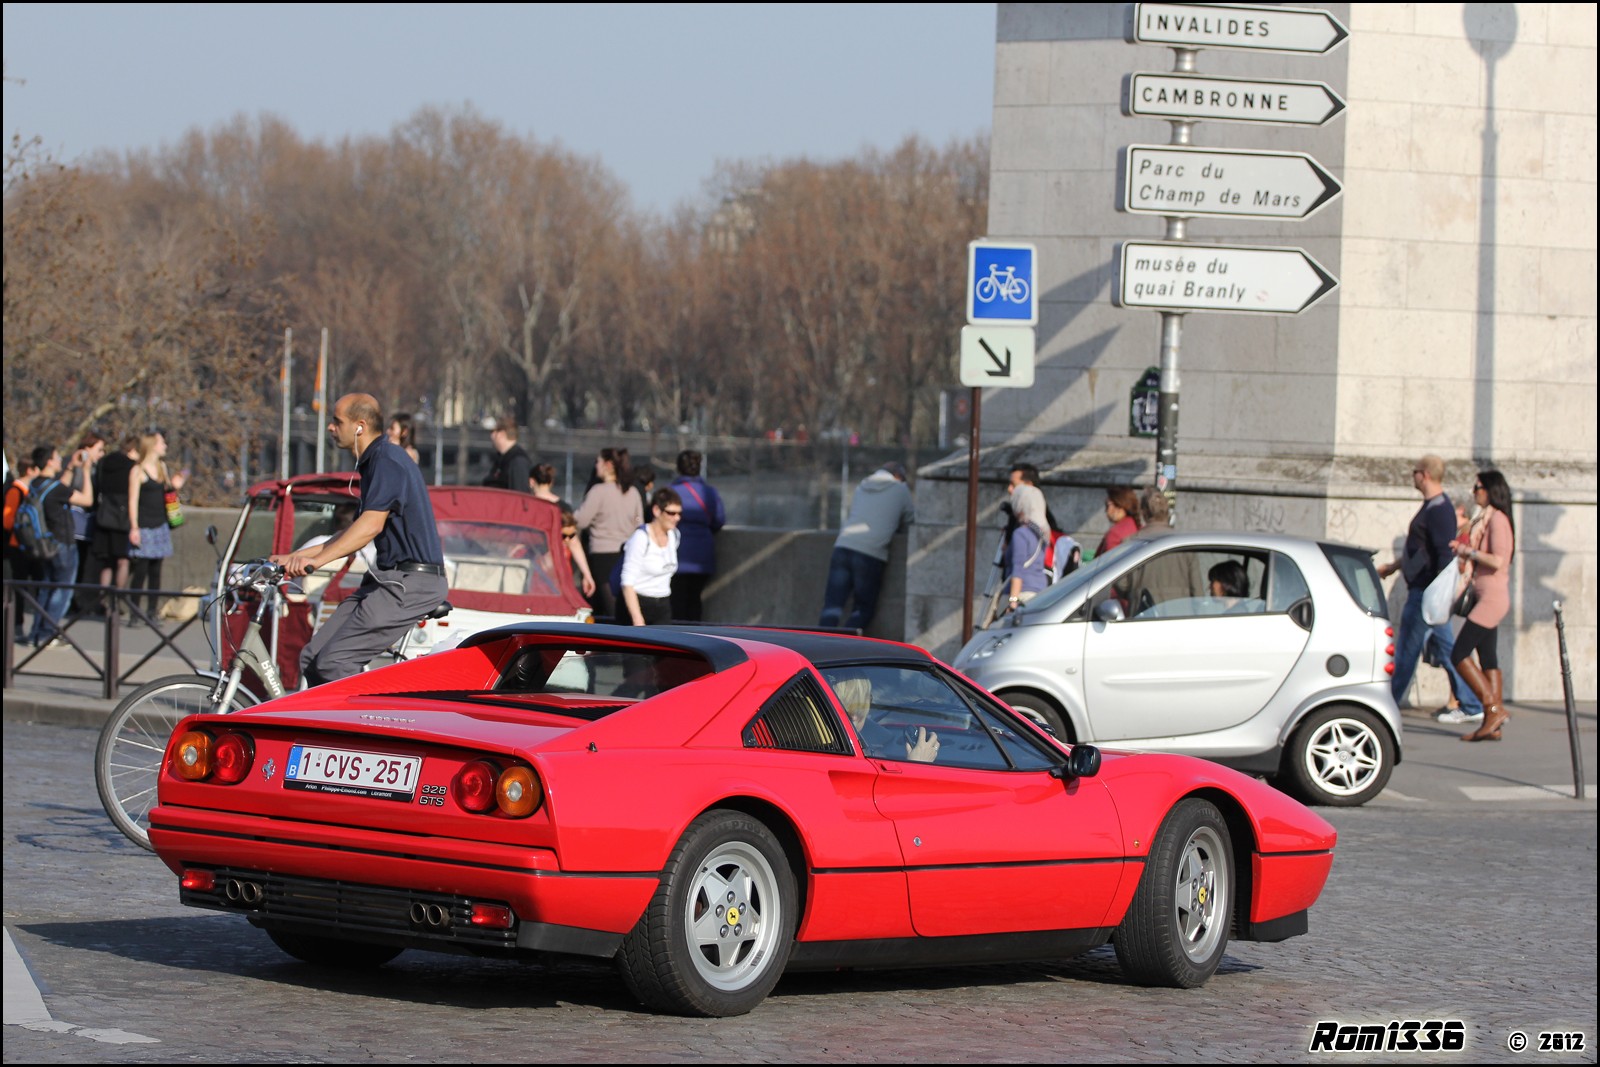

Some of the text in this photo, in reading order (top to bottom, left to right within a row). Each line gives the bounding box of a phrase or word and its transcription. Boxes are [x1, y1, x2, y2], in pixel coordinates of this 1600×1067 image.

[1146, 14, 1270, 37] INVALIDES
[1142, 87, 1288, 111] CAMBRONNE
[1139, 159, 1224, 179] Parc du
[1139, 185, 1302, 208] Champ de Mars
[1135, 256, 1229, 274] musée du
[1133, 281, 1247, 302] quai Branly
[288, 764, 297, 776] B
[421, 785, 447, 795] 328
[419, 795, 445, 806] GTS
